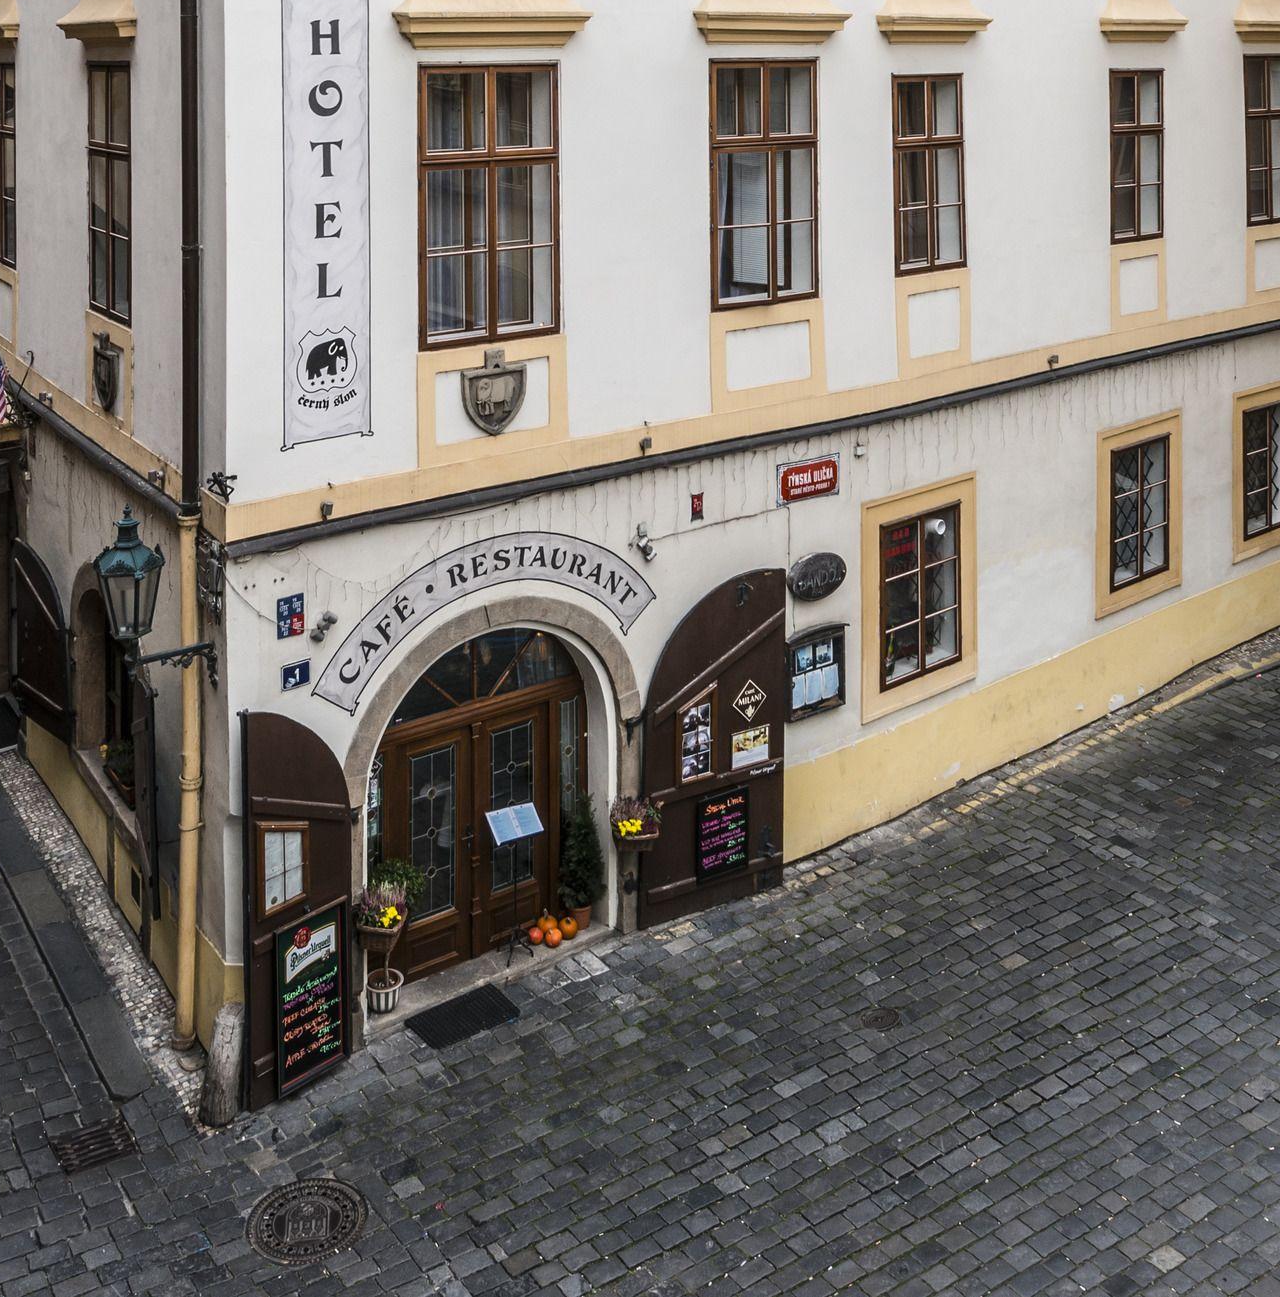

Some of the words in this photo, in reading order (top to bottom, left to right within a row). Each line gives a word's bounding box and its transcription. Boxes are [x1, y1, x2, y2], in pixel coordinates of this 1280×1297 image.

[308, 19, 343, 300] HOTEL
[787, 469, 812, 488] TÝNSKÁ
[813, 464, 834, 482] ULIČKA
[339, 595, 415, 684] CAFÉ
[446, 545, 638, 605] RESTAURANT
[738, 693, 762, 706] MILANI
